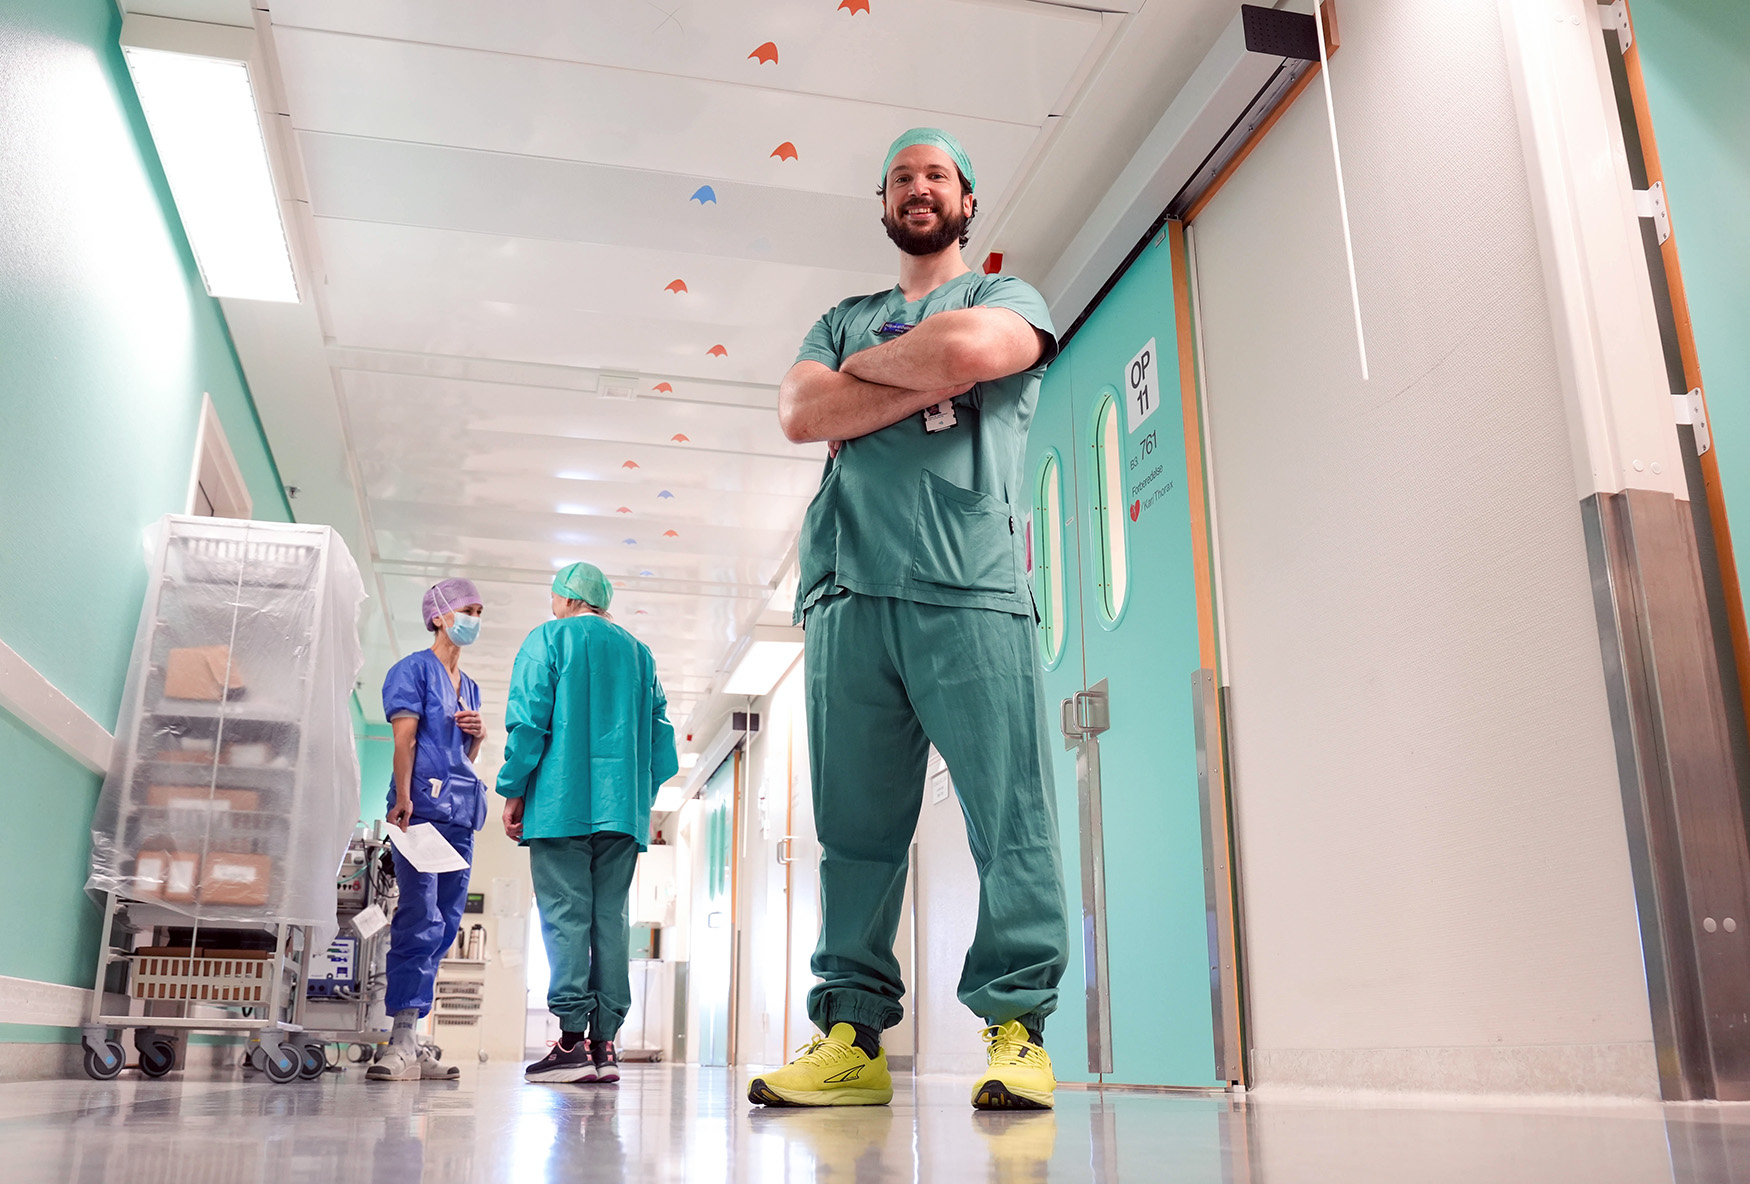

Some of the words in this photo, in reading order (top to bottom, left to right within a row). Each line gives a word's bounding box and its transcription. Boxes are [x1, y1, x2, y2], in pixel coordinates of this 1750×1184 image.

[1131, 350, 1150, 389] OP
[1137, 384, 1149, 415] 11
[1140, 429, 1157, 460] 761
[1132, 464, 1163, 497] Forberedelse
